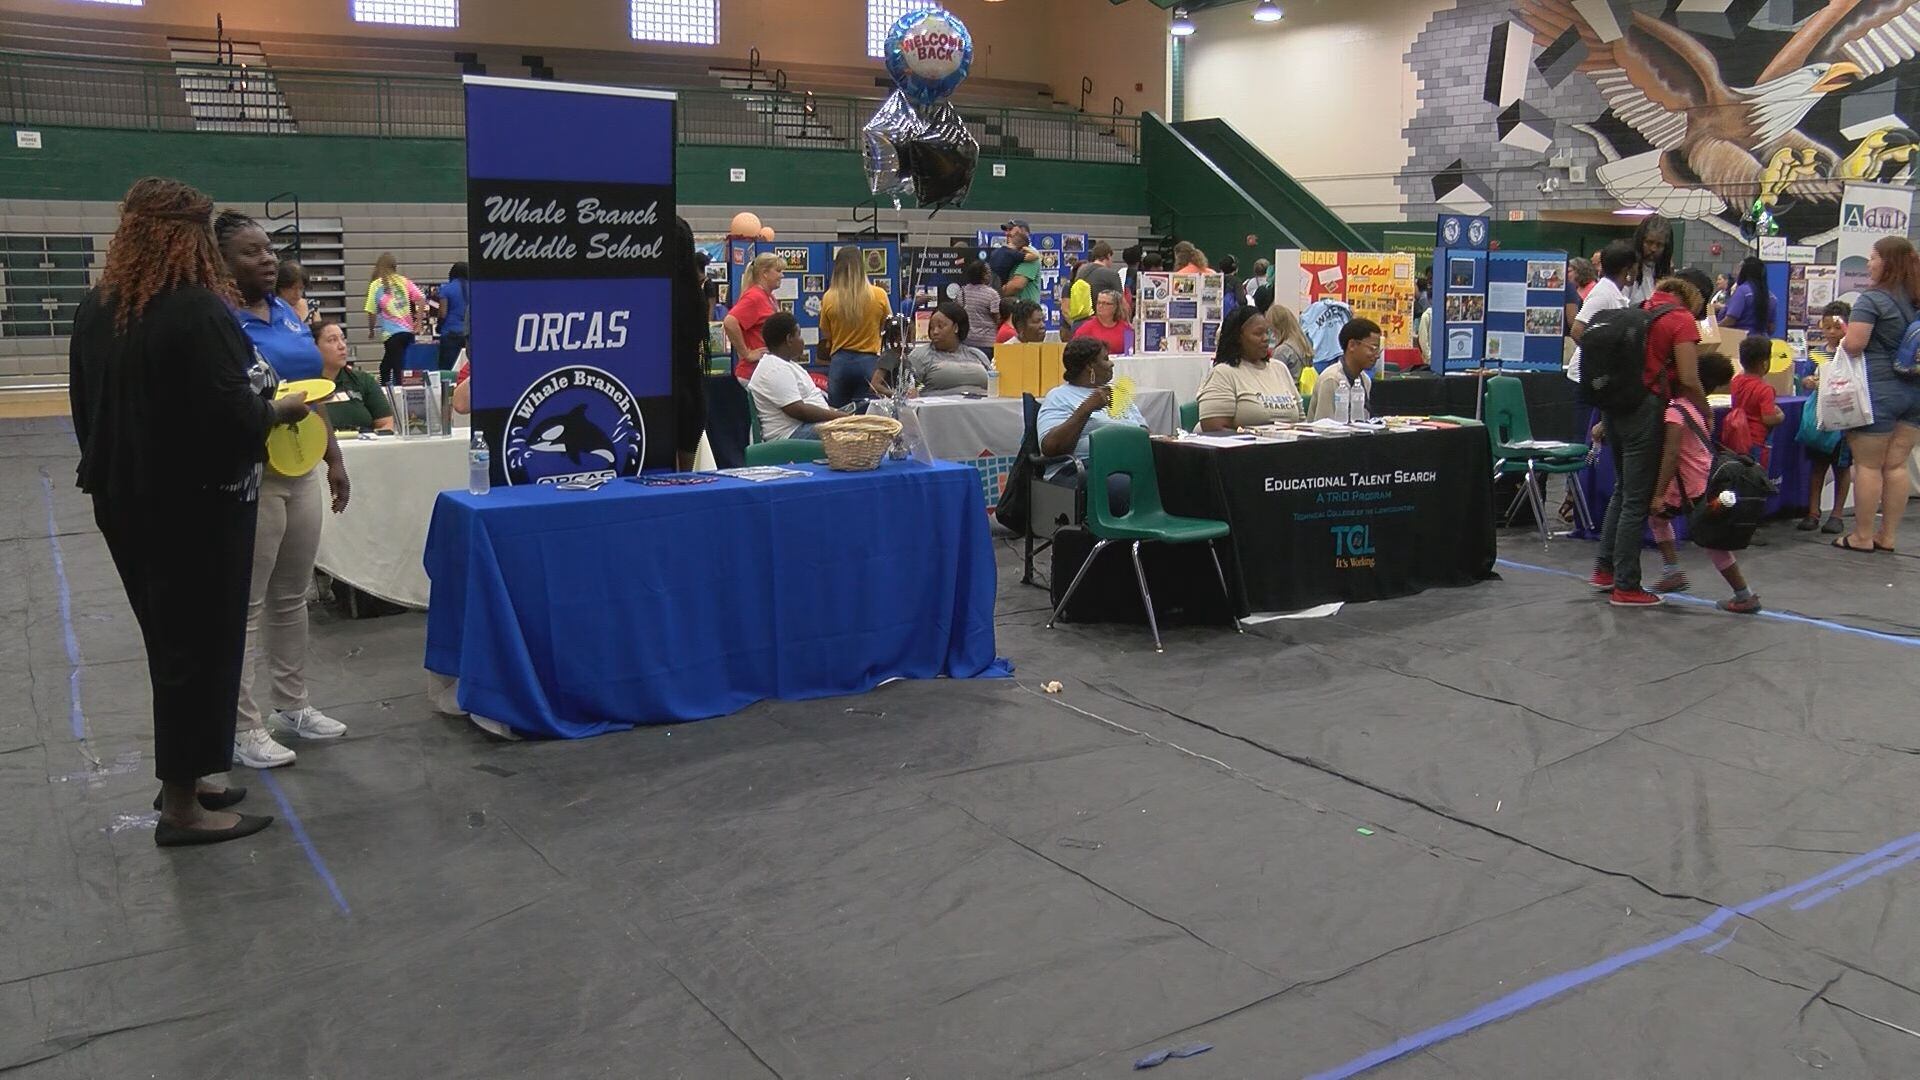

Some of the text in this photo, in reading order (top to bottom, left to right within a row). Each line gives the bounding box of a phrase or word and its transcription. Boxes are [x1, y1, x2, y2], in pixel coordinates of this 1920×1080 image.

[901, 32, 964, 53] WELCOME
[918, 46, 954, 61] BACK
[484, 196, 658, 225] Whale Branch
[1844, 205, 1908, 230] Adult
[479, 231, 663, 261] Middle School
[777, 249, 807, 259] MOSSY
[1347, 264, 1390, 276] ed Cedar
[1348, 282, 1395, 296] mentary
[514, 310, 631, 353] ORCAS
[516, 369, 632, 421] Whale Branch
[1263, 401, 1296, 410] SEARCH
[1264, 470, 1437, 492] EDUCATIONAL TALENT SEARCH
[1315, 493, 1325, 503] A
[1352, 490, 1392, 501] PROGRAM
[1330, 524, 1376, 556] TCL
[1335, 558, 1349, 568] It's
